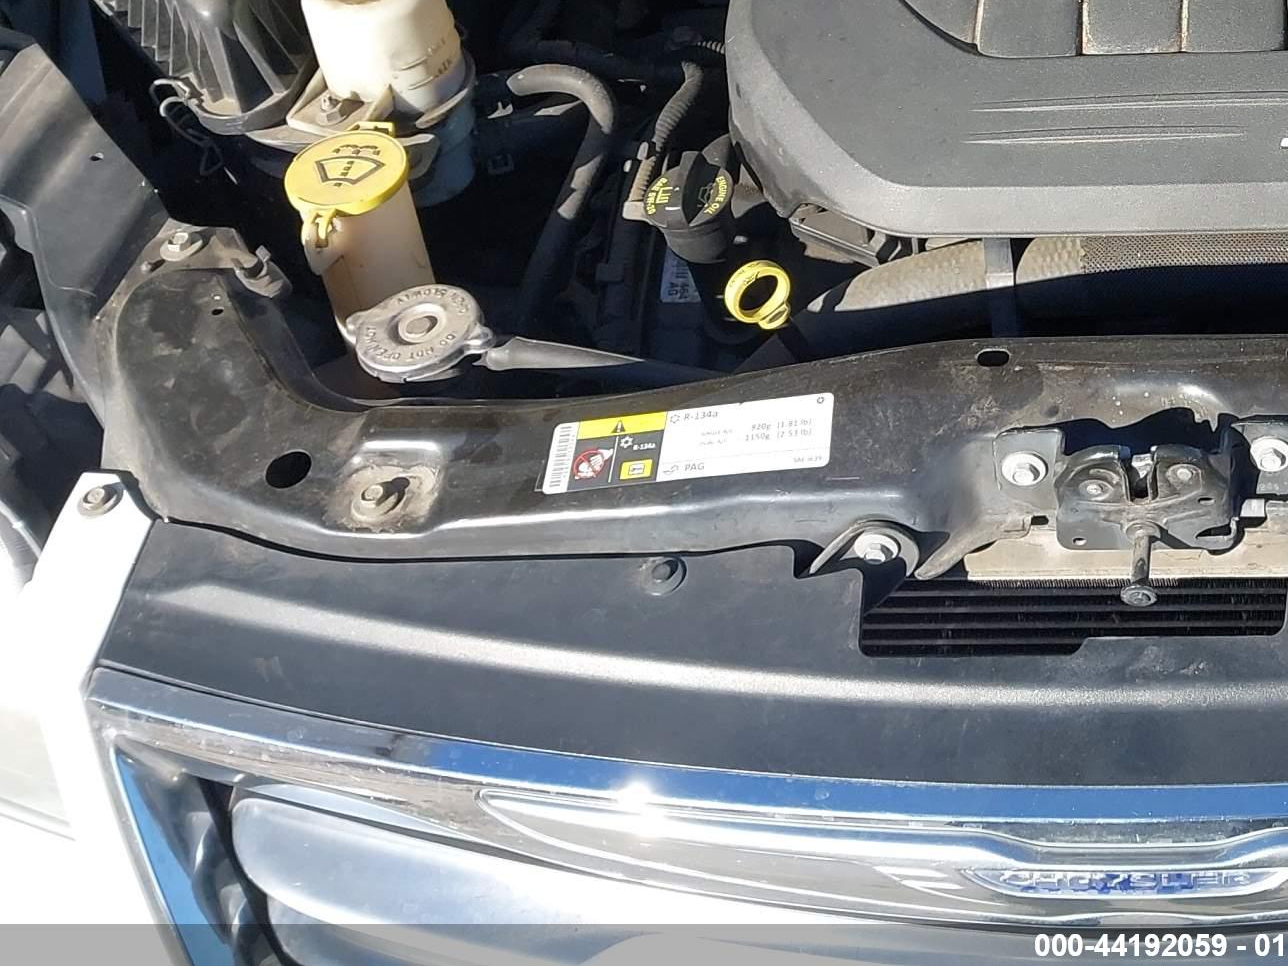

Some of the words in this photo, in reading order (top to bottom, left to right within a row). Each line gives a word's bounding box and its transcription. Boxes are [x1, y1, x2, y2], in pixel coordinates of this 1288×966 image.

[716, 176, 727, 202] ENGINE
[704, 203, 720, 214] OIL
[684, 411, 718, 420] R-134a
[684, 463, 705, 471] PAG
